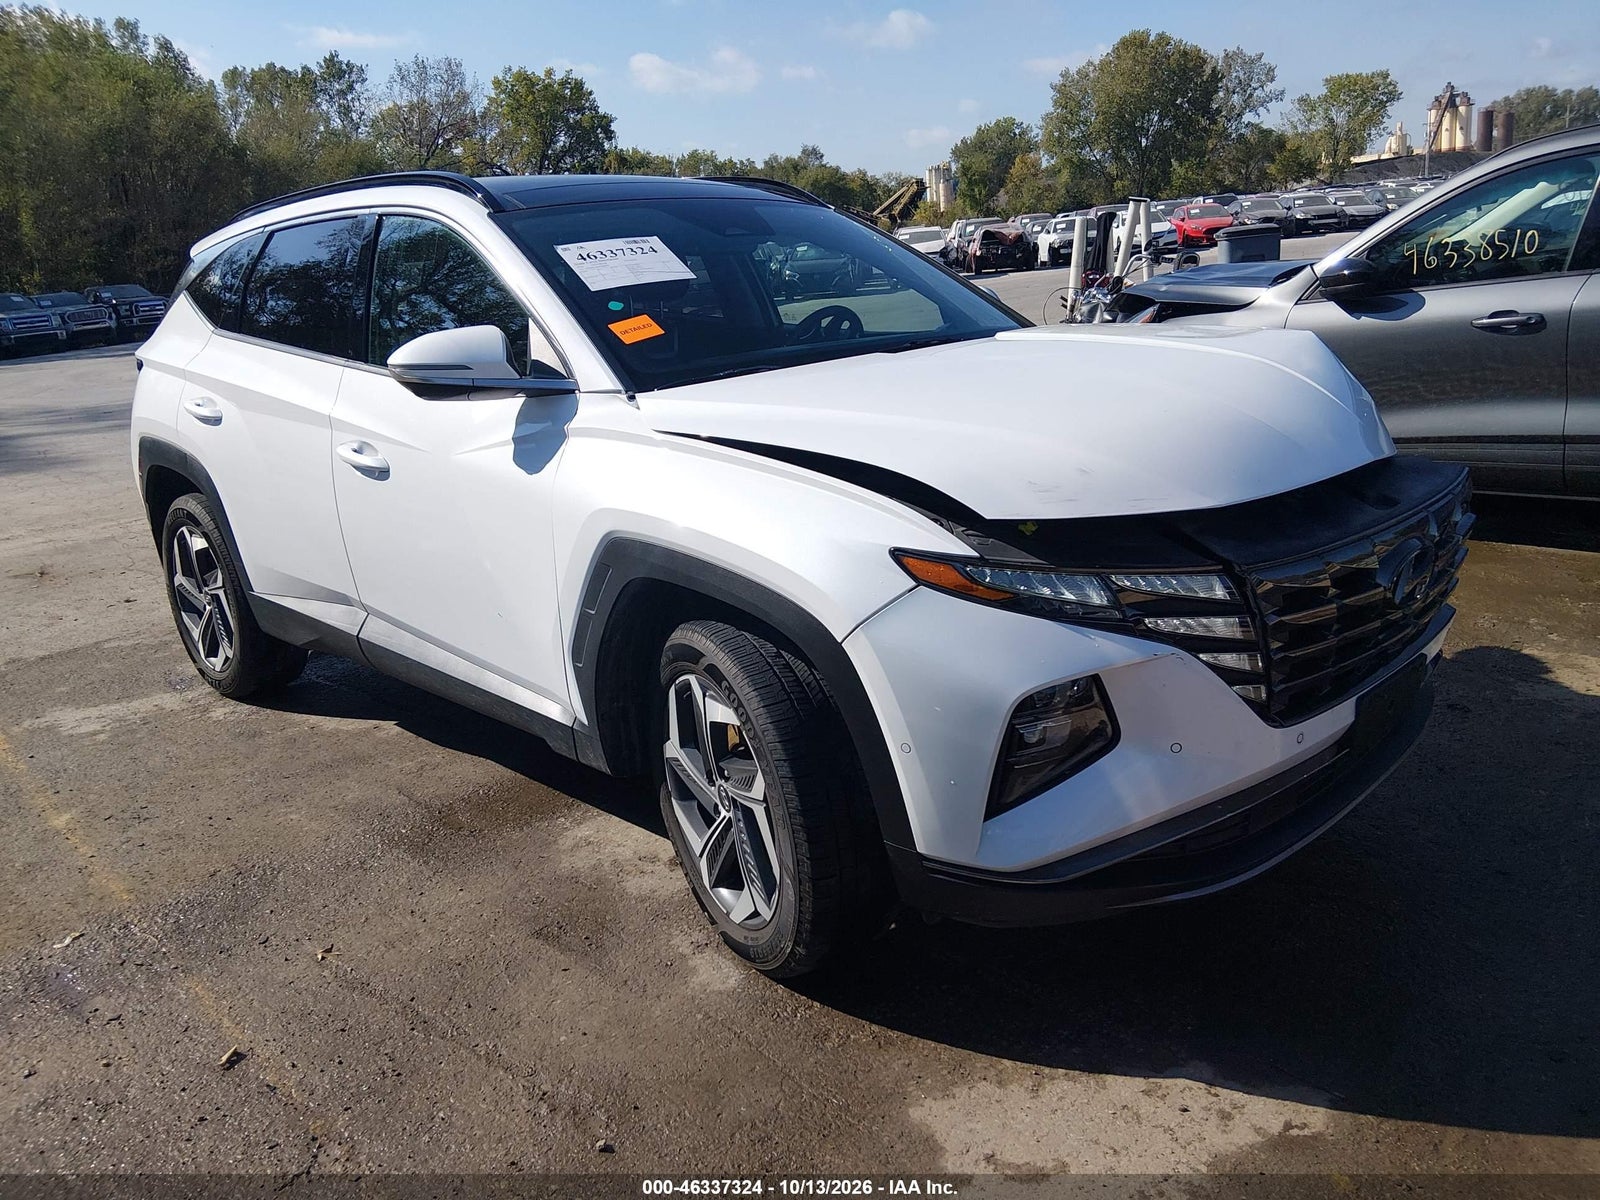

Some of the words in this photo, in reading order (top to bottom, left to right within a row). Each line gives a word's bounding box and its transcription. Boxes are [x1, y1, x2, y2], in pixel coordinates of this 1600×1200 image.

[576, 246, 658, 262] 46337324
[1404, 229, 1539, 275] 46338510
[619, 322, 653, 336] DETAILED
